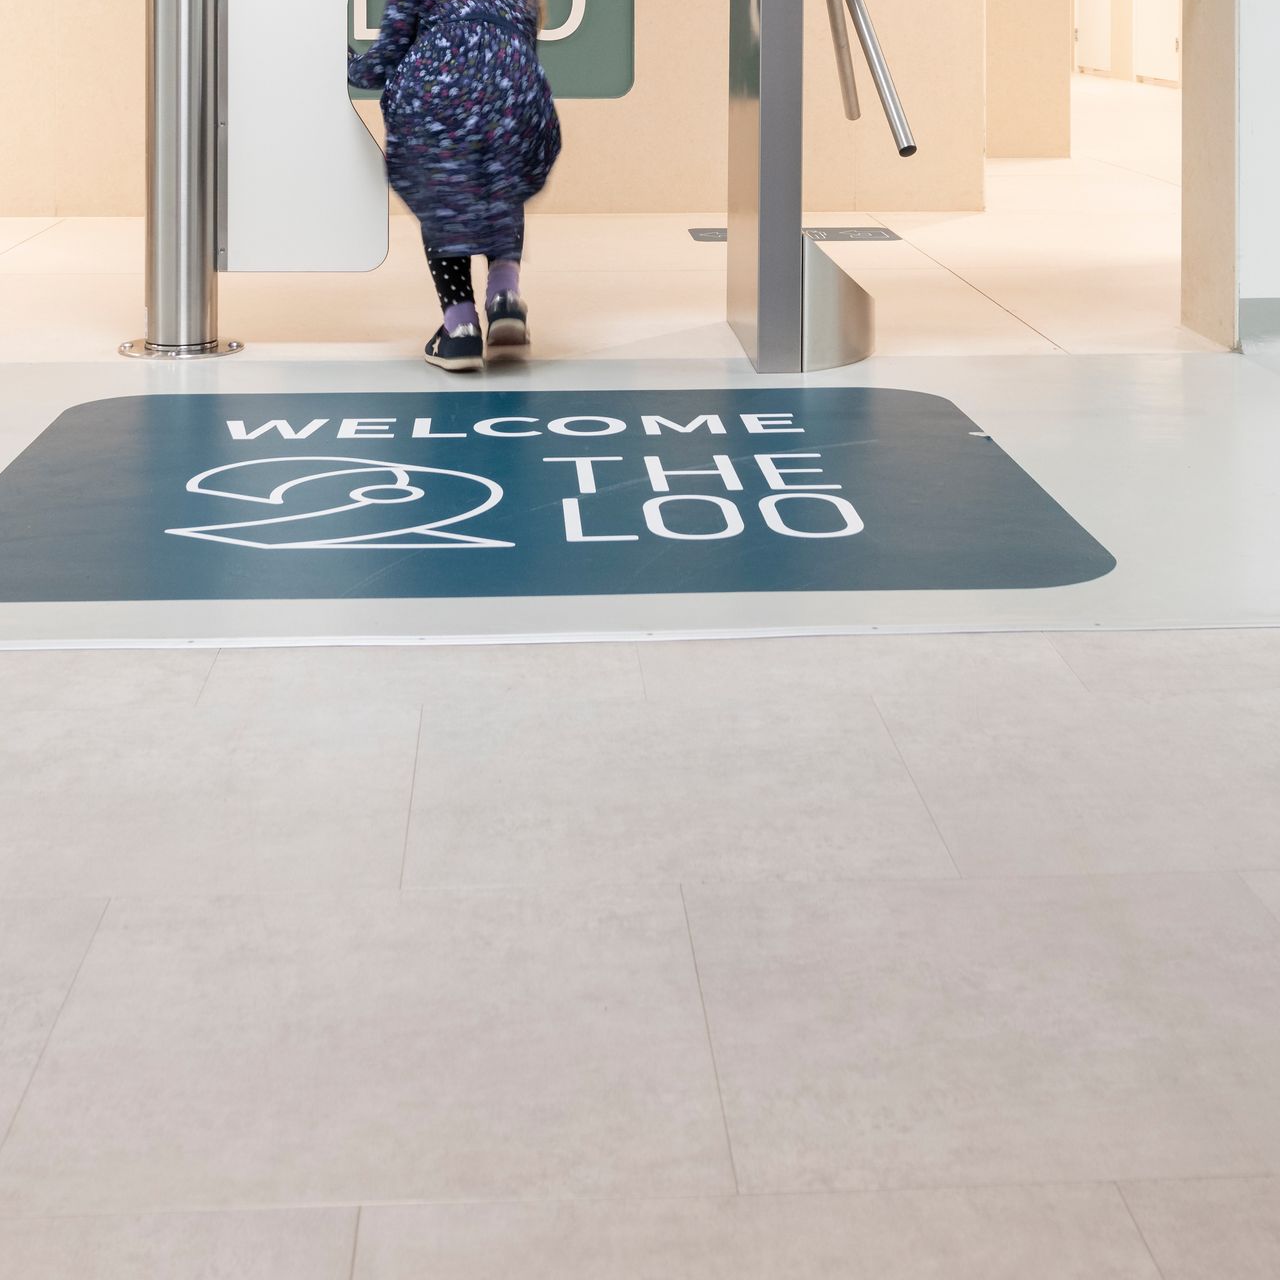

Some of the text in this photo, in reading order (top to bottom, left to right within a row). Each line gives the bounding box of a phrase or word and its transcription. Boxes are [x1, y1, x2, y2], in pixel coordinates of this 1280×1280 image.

[225, 413, 806, 441] WELCOME
[542, 453, 843, 494] THE
[561, 492, 865, 543] LOO
